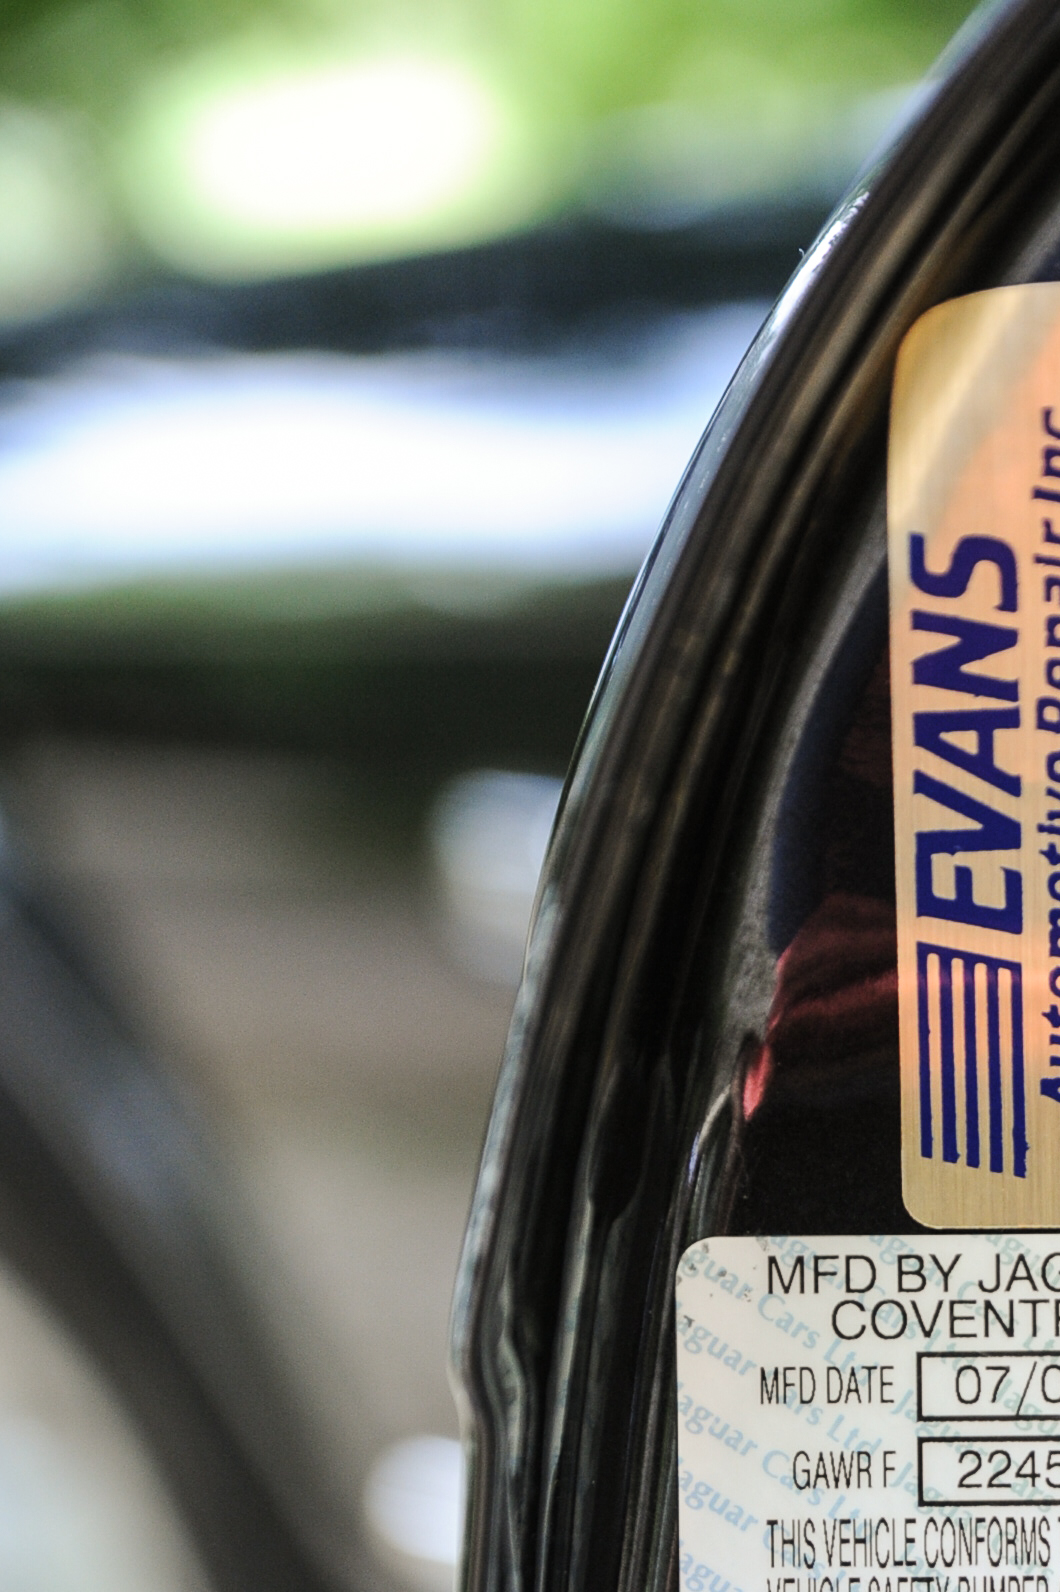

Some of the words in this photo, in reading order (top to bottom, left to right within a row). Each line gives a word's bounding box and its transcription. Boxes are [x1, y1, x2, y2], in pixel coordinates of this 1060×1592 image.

[909, 533, 1024, 935] EVANS
[767, 1254, 877, 1295] MFD
[897, 1253, 962, 1293] BY
[760, 1366, 816, 1405] MFD
[826, 1365, 895, 1404] DATE
[792, 1450, 872, 1491] GAWR
[883, 1450, 896, 1488] F
[766, 1518, 816, 1570] THIS
[822, 1517, 917, 1569] VEHICLE
[924, 1515, 1051, 1569] CONFORMS
